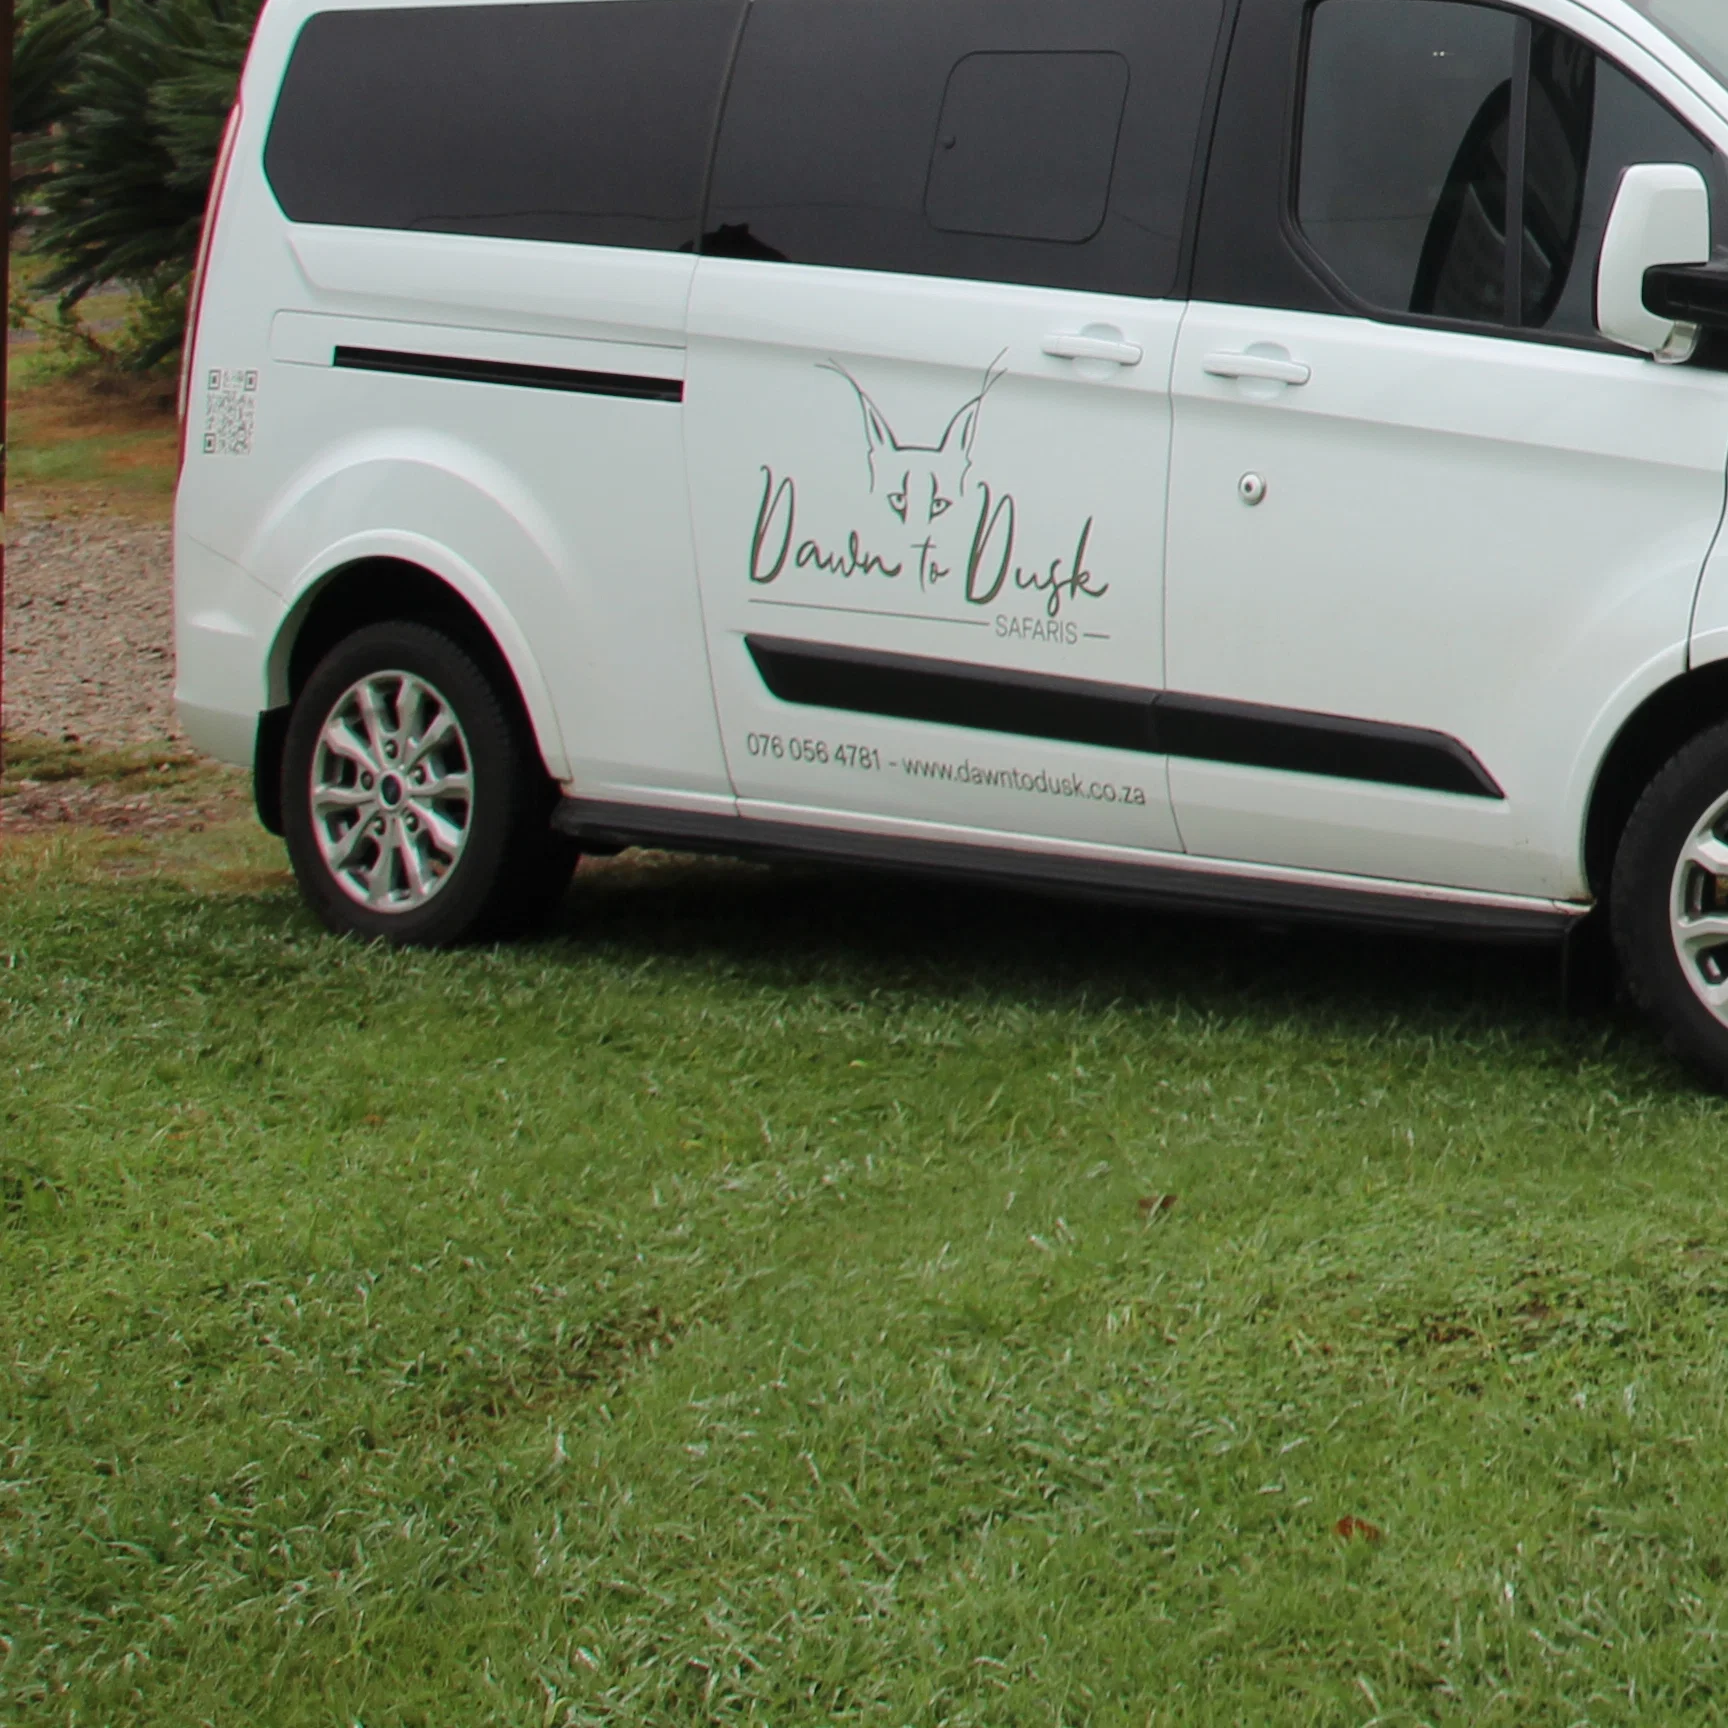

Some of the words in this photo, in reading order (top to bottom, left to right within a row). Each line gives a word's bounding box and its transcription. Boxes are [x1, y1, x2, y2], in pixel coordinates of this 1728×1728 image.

[749, 464, 902, 584] Dawn
[911, 535, 950, 592] to
[966, 480, 1109, 617] Dusk
[995, 615, 1078, 646] SAFARIS
[747, 733, 784, 760] 076
[790, 737, 828, 765] 056
[834, 743, 882, 771] 4781
[902, 756, 1146, 805] www.dawntodusk.co.za
